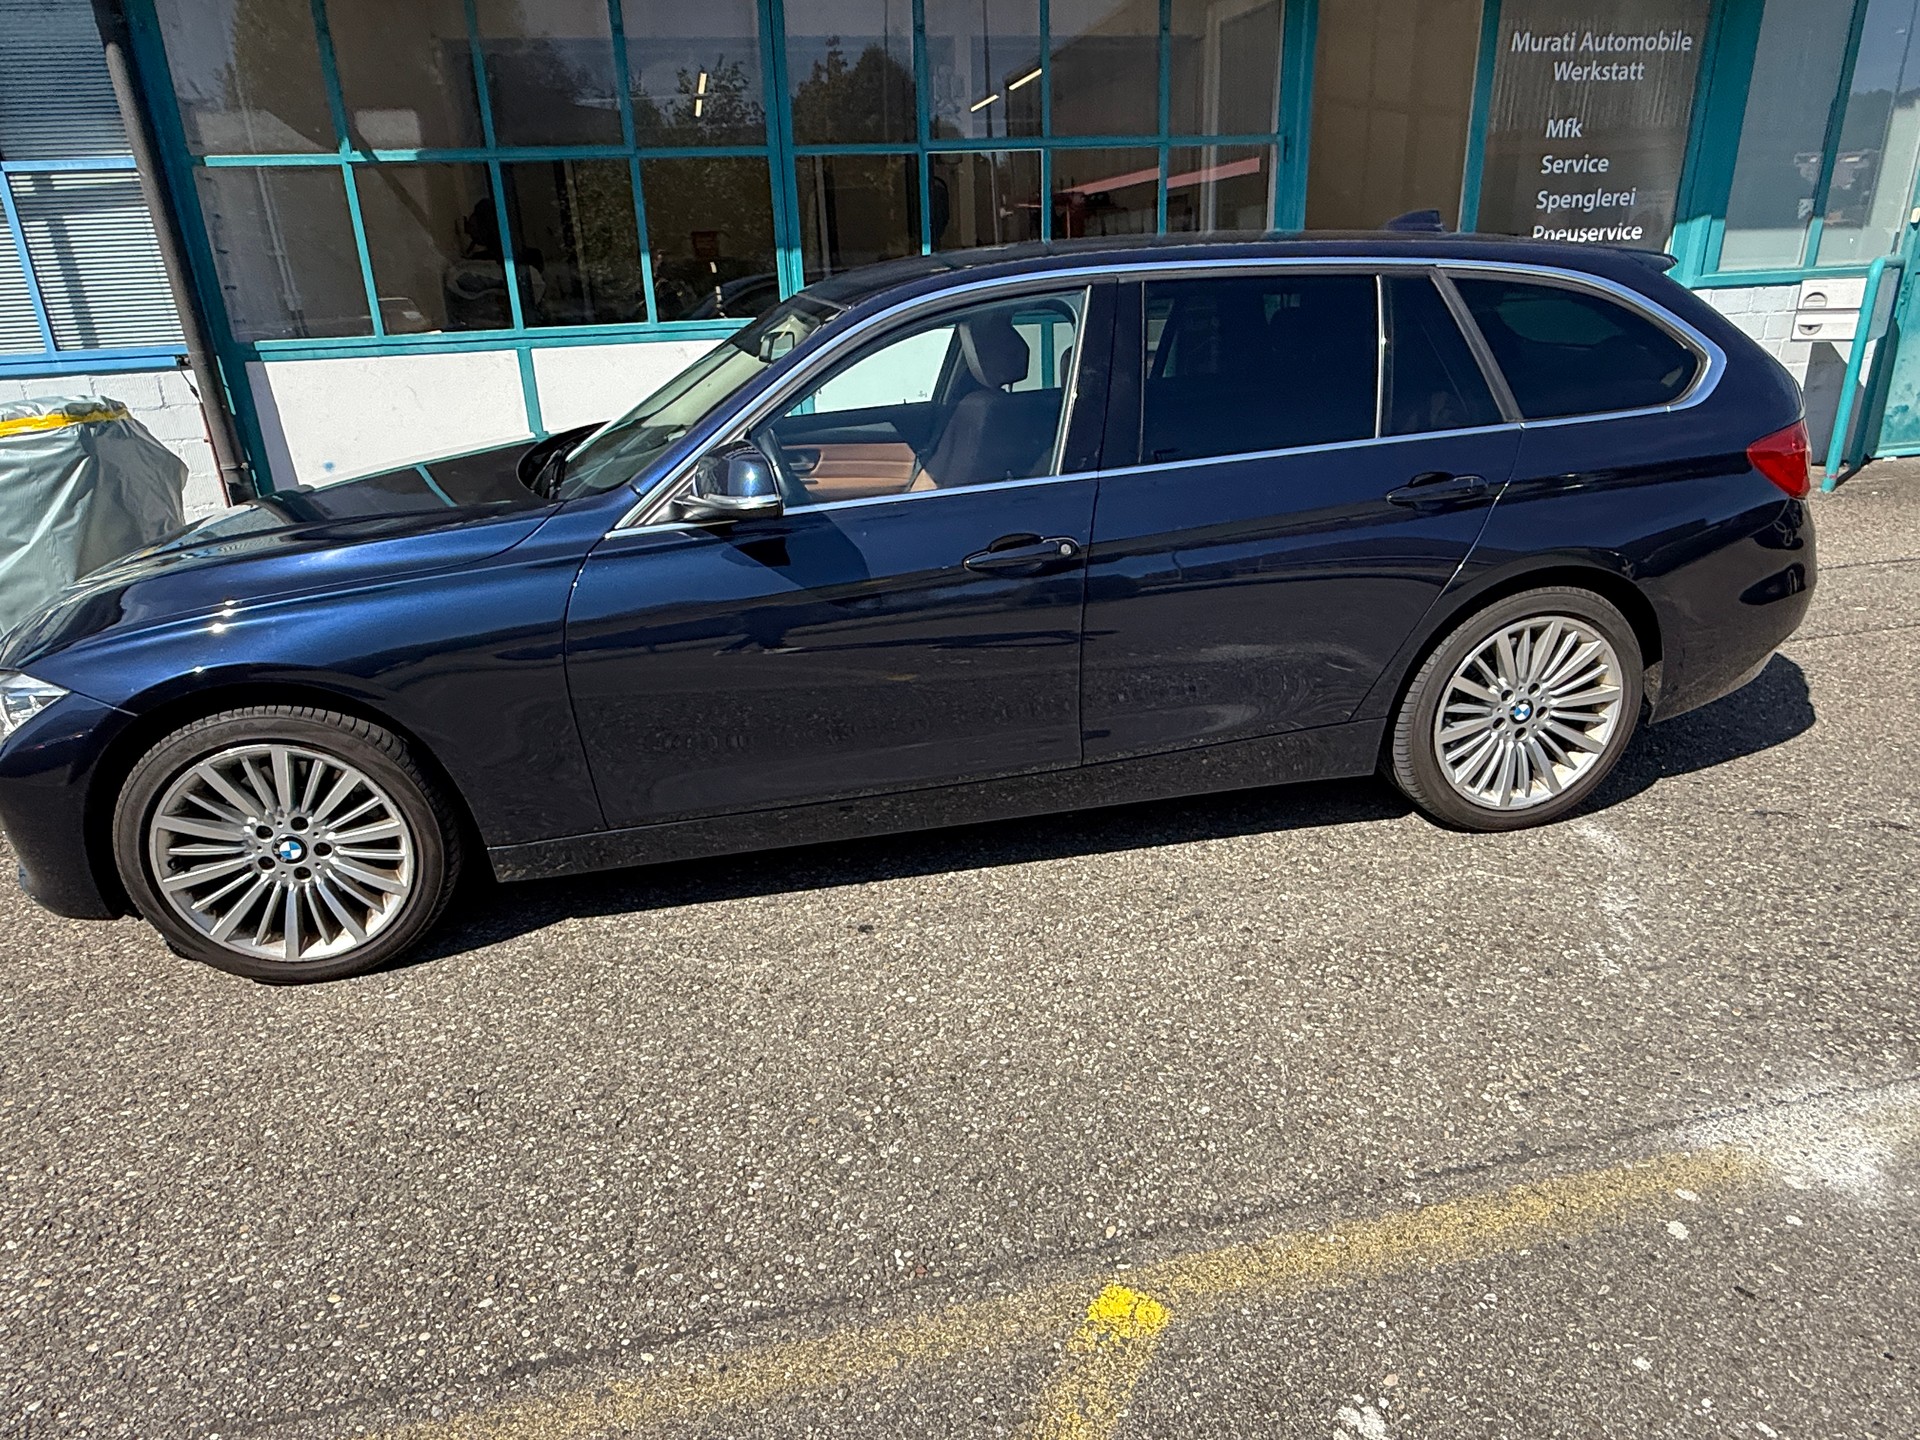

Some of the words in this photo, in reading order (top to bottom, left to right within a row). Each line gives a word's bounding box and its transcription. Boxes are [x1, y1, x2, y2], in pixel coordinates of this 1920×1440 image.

[1511, 31, 1576, 52] Murati
[1579, 29, 1693, 51] Automobile
[1553, 61, 1645, 81] Werkstatt
[1545, 118, 1582, 139] Mfk
[1541, 154, 1609, 174] Service
[1536, 187, 1637, 213] Spenglerei
